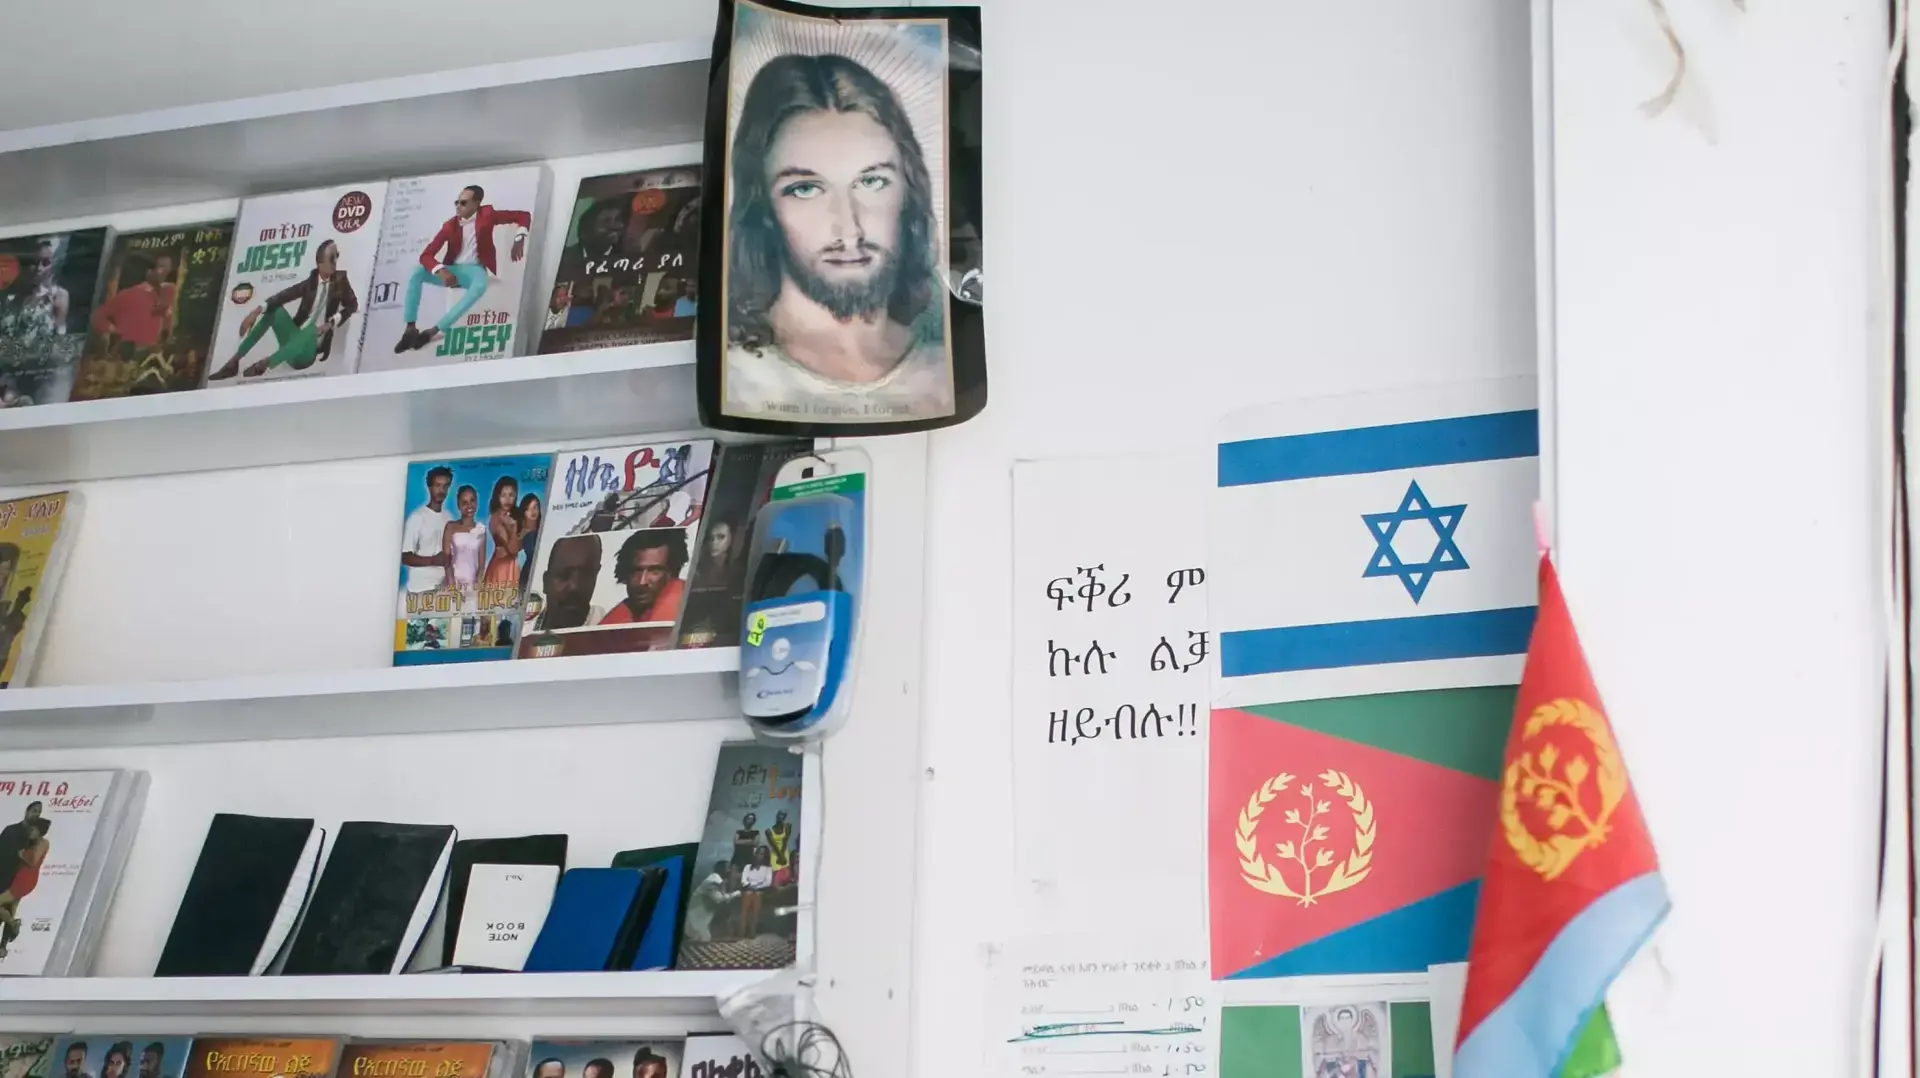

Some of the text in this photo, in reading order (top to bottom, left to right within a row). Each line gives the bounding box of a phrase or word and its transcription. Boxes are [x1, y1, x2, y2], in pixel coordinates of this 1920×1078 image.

[338, 205, 365, 218] DVD
[236, 240, 308, 274] JOSSY
[436, 324, 512, 357] JOSSY
[1046, 563, 1131, 612] ፍቕሪ
[1048, 639, 1117, 677] ኩሉ
[1048, 703, 1196, 746] ዘይብሉ!!
[48, 794, 98, 809] Makbel
[486, 922, 525, 930] BOOK
